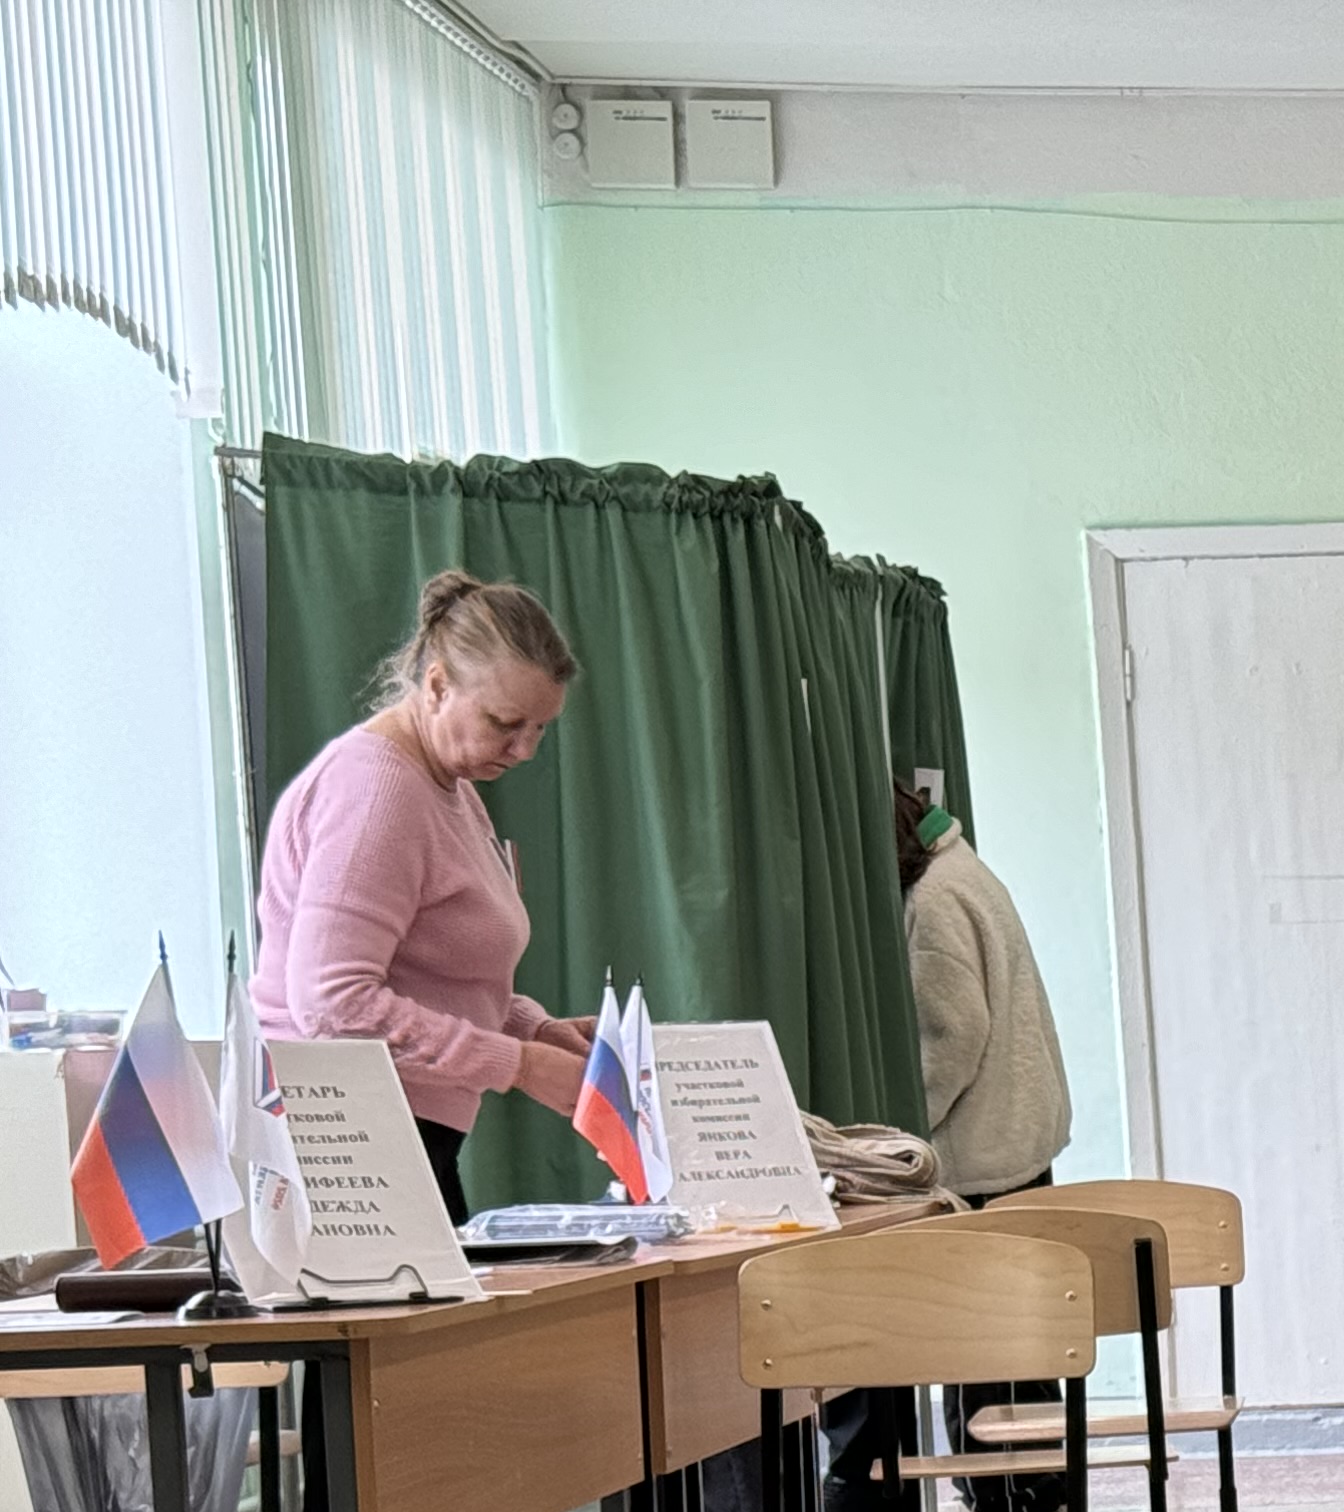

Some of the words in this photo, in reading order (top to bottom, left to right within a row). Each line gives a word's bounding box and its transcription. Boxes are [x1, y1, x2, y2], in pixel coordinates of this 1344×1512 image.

[280, 1085, 346, 1099] ЕТАРЬ
[286, 1109, 347, 1123] тковой
[298, 1155, 354, 1166] иссии
[310, 1199, 381, 1215] ДЕЖДА
